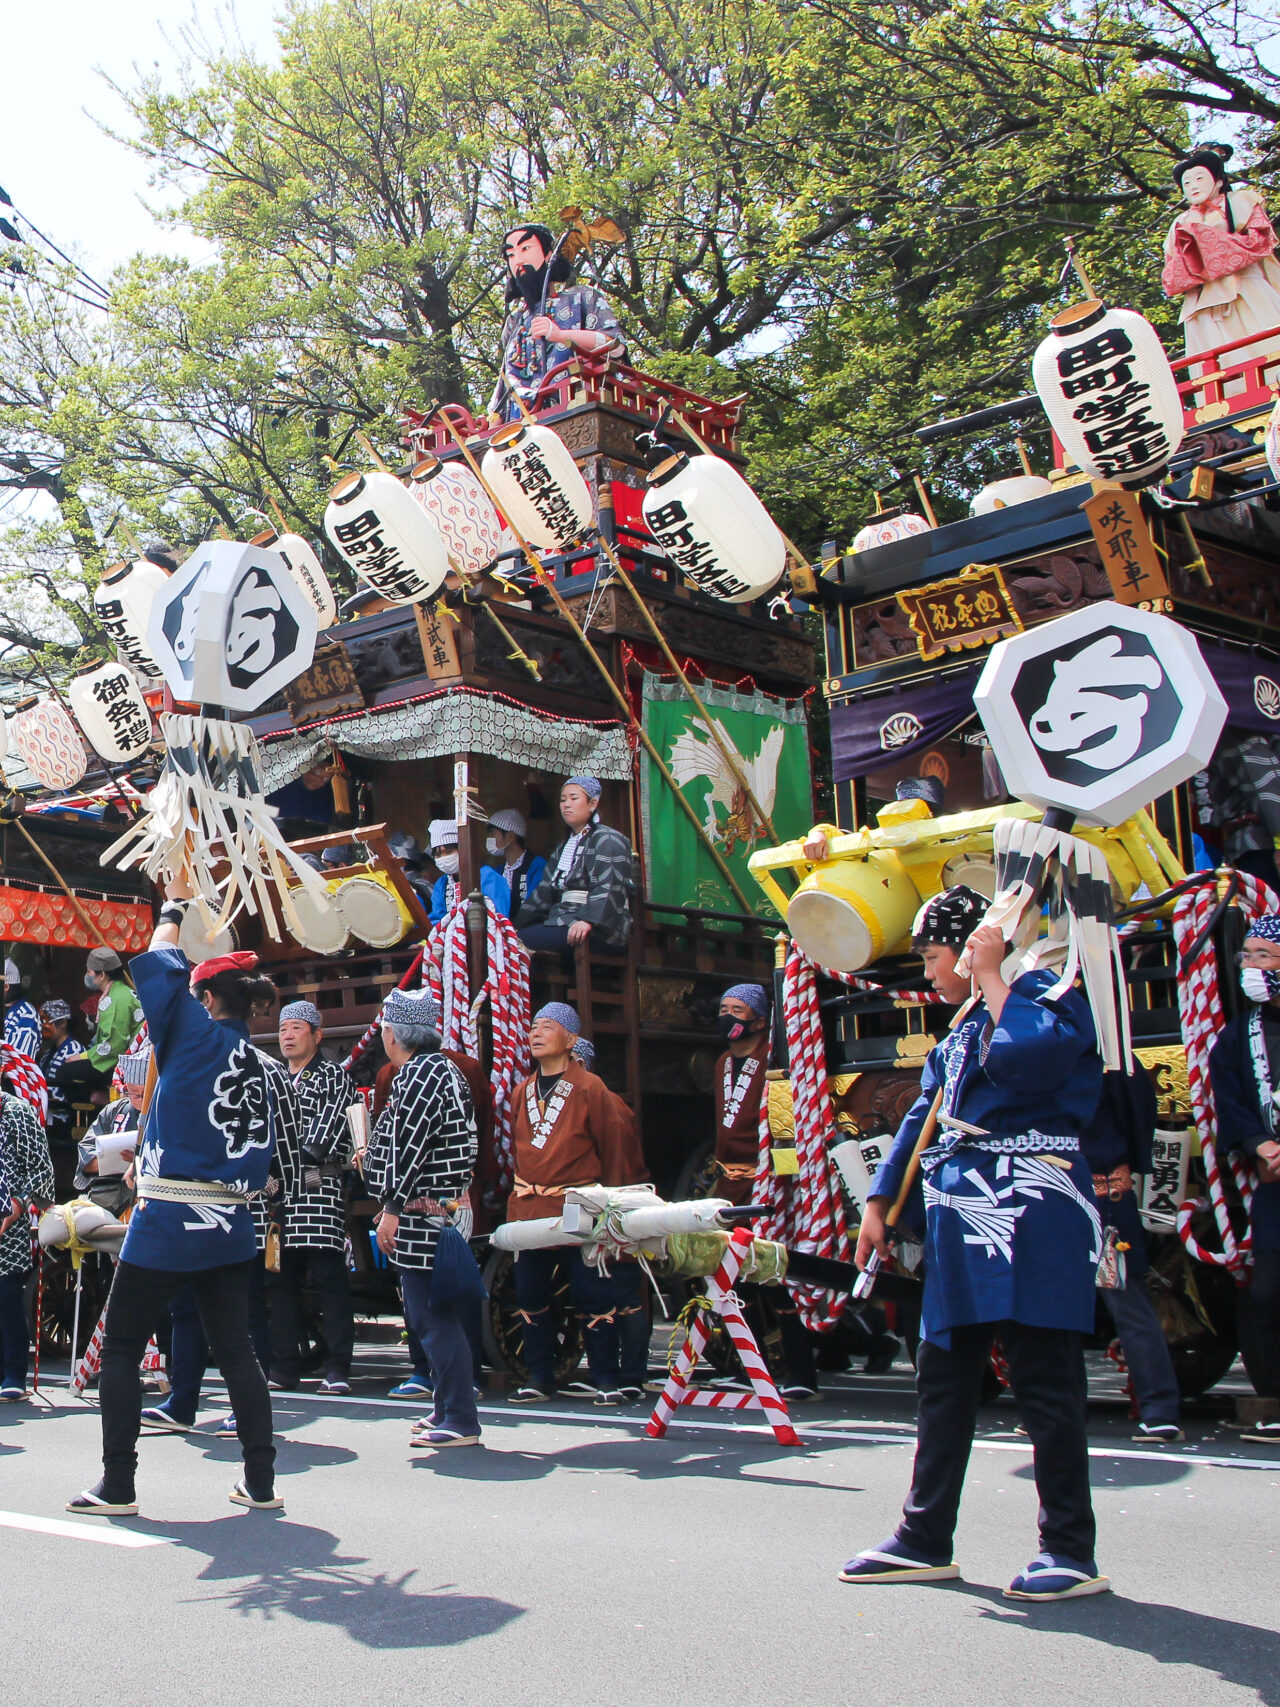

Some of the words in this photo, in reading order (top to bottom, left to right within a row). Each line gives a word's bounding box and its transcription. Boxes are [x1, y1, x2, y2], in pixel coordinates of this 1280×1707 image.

[1097, 500, 1151, 592] 咲耶車
[92, 673, 150, 751] 御祭禮
